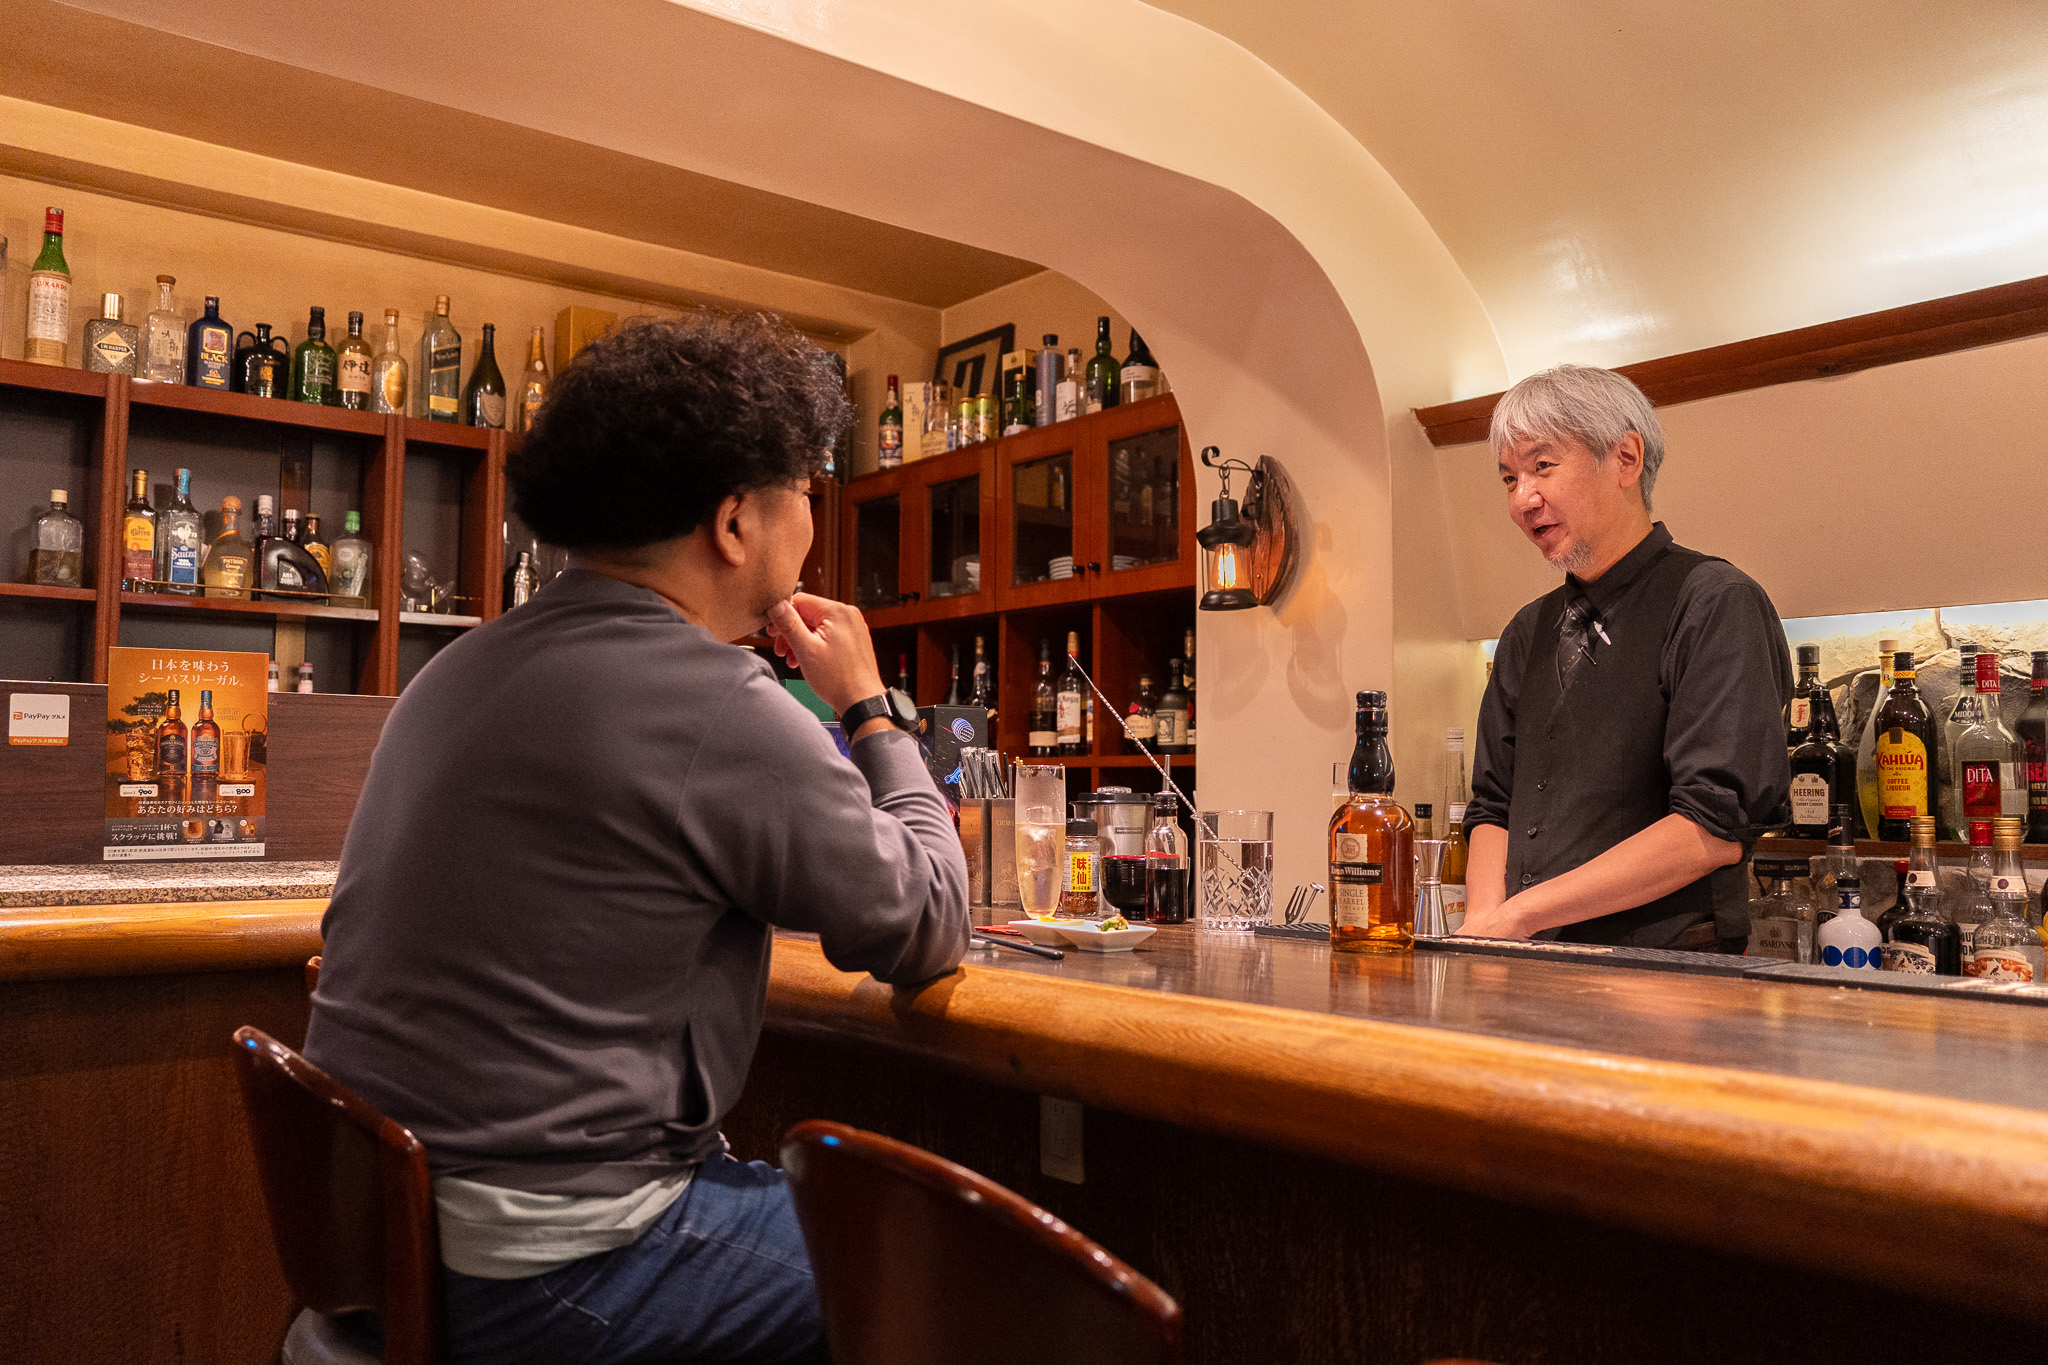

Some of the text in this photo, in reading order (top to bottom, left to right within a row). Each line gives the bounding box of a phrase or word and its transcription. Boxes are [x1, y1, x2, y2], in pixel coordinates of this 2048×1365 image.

[36, 281, 68, 291] LUXARDO
[201, 352, 228, 363] BLACK
[152, 659, 230, 672] 日本を味わう
[139, 672, 244, 688] シーバスリーガル。
[1981, 679, 1997, 688] DITA
[1876, 751, 1924, 771] KAHLÚA
[1967, 768, 1994, 783] DITA
[1793, 788, 1825, 797] HEERING
[1076, 857, 1087, 885] 味仙
[1338, 888, 1364, 898] SINGLE
